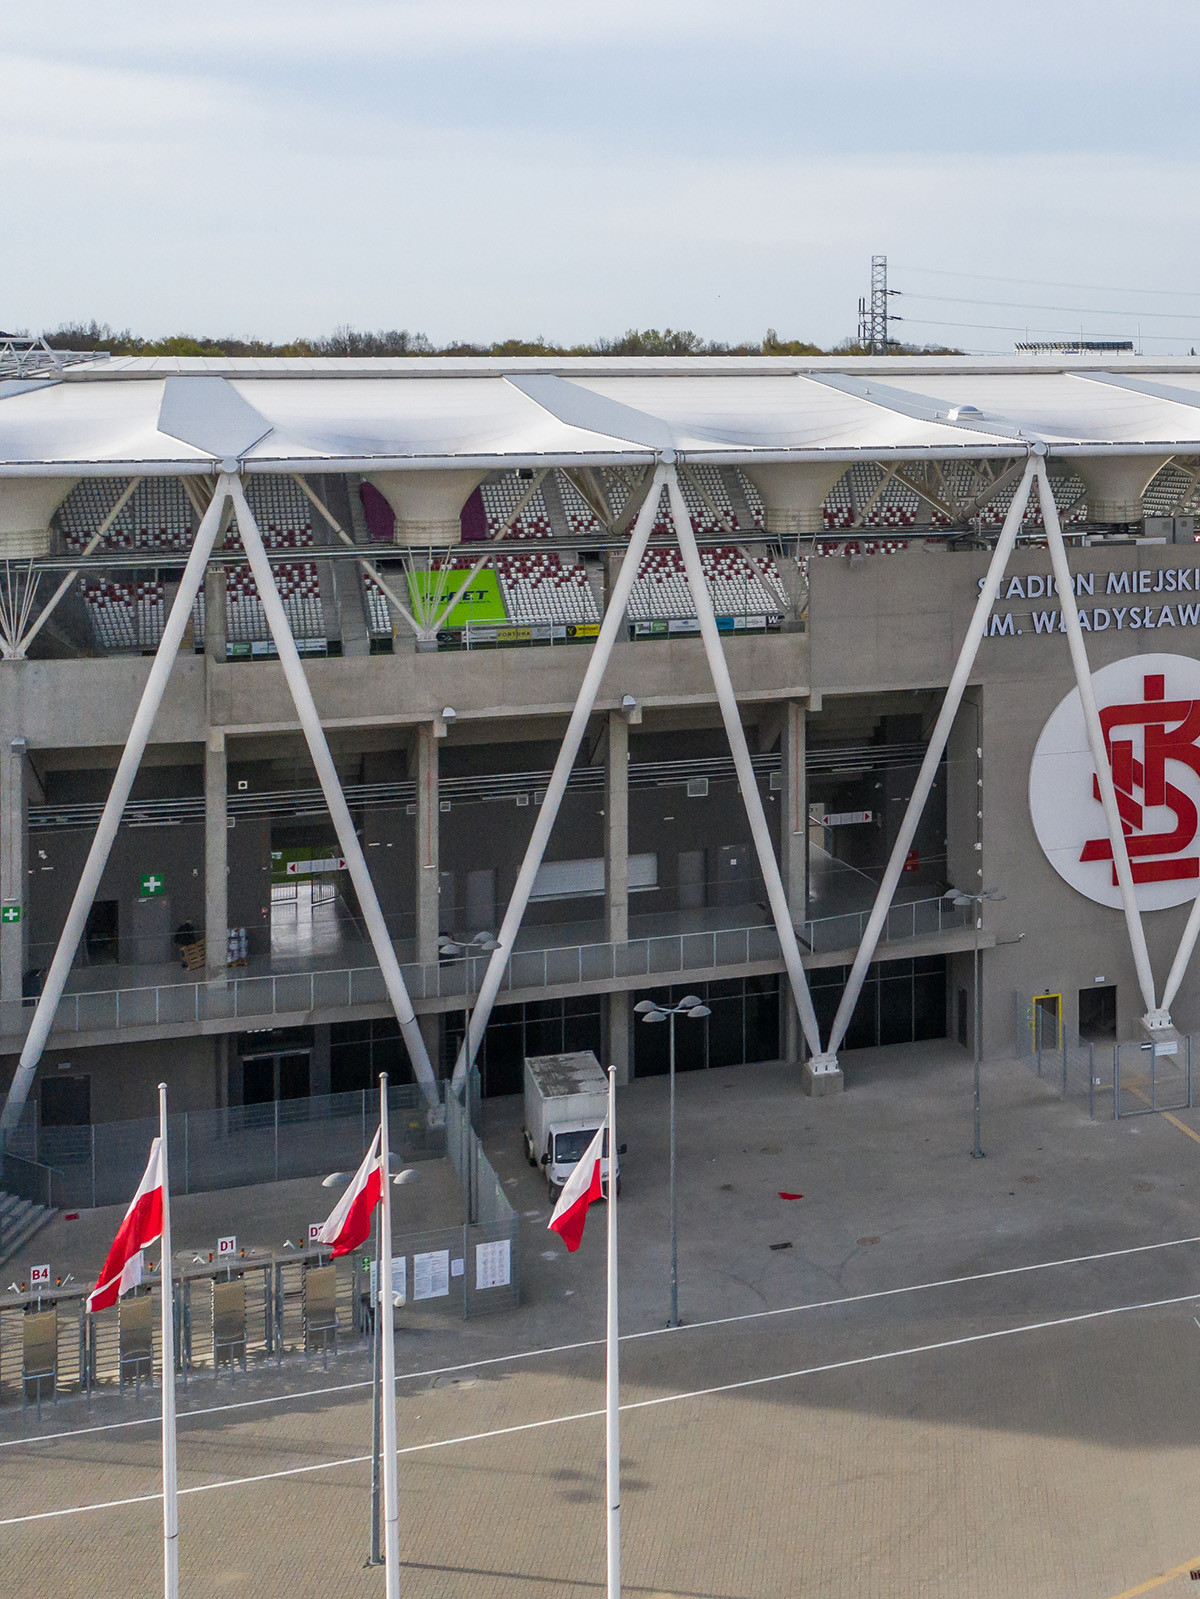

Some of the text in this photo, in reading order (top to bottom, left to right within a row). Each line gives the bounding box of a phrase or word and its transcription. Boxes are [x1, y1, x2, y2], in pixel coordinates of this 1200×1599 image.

[1106, 568, 1200, 595] MIEJSKI
[983, 612, 1023, 637] IM.
[220, 1240, 234, 1251] D1
[32, 1268, 48, 1280] B4
